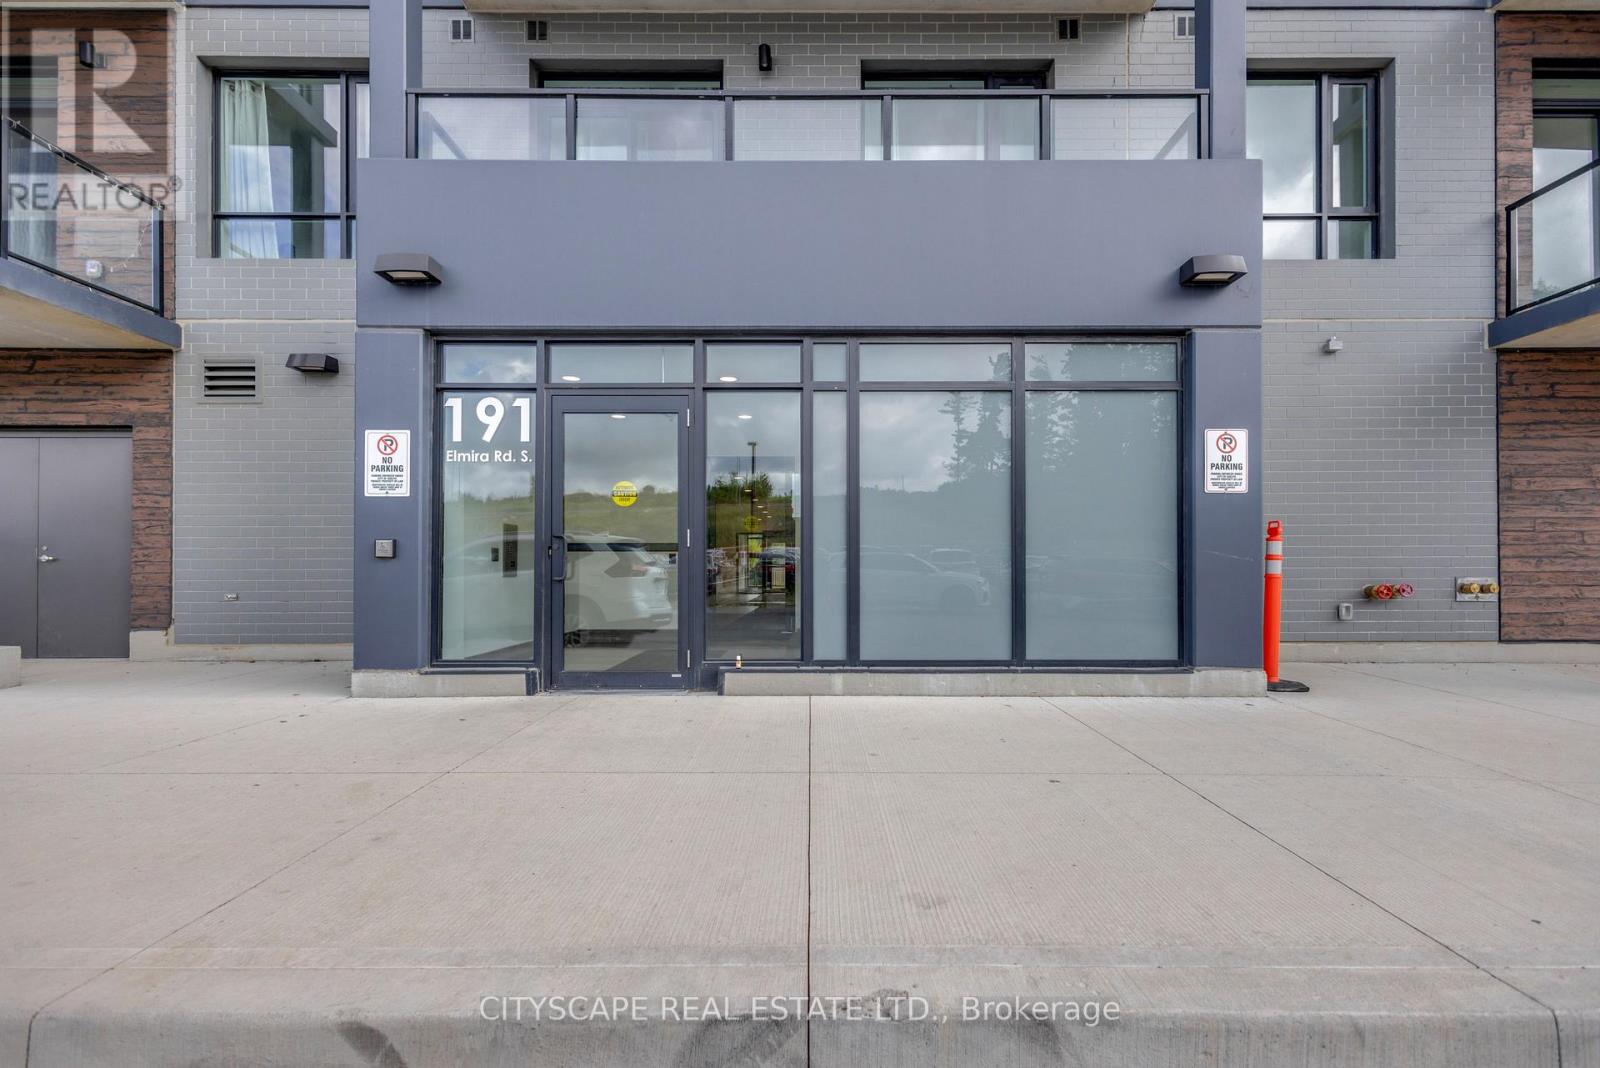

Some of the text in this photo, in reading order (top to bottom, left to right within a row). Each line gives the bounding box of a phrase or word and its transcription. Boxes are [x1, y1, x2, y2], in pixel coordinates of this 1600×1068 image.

[444, 396, 530, 443] 191
[381, 456, 393, 464] NO
[446, 450, 533, 462] Elmira Rd. S.
[1221, 454, 1232, 462] NO
[370, 464, 404, 473] PARKING
[1210, 462, 1243, 471] PARKING
